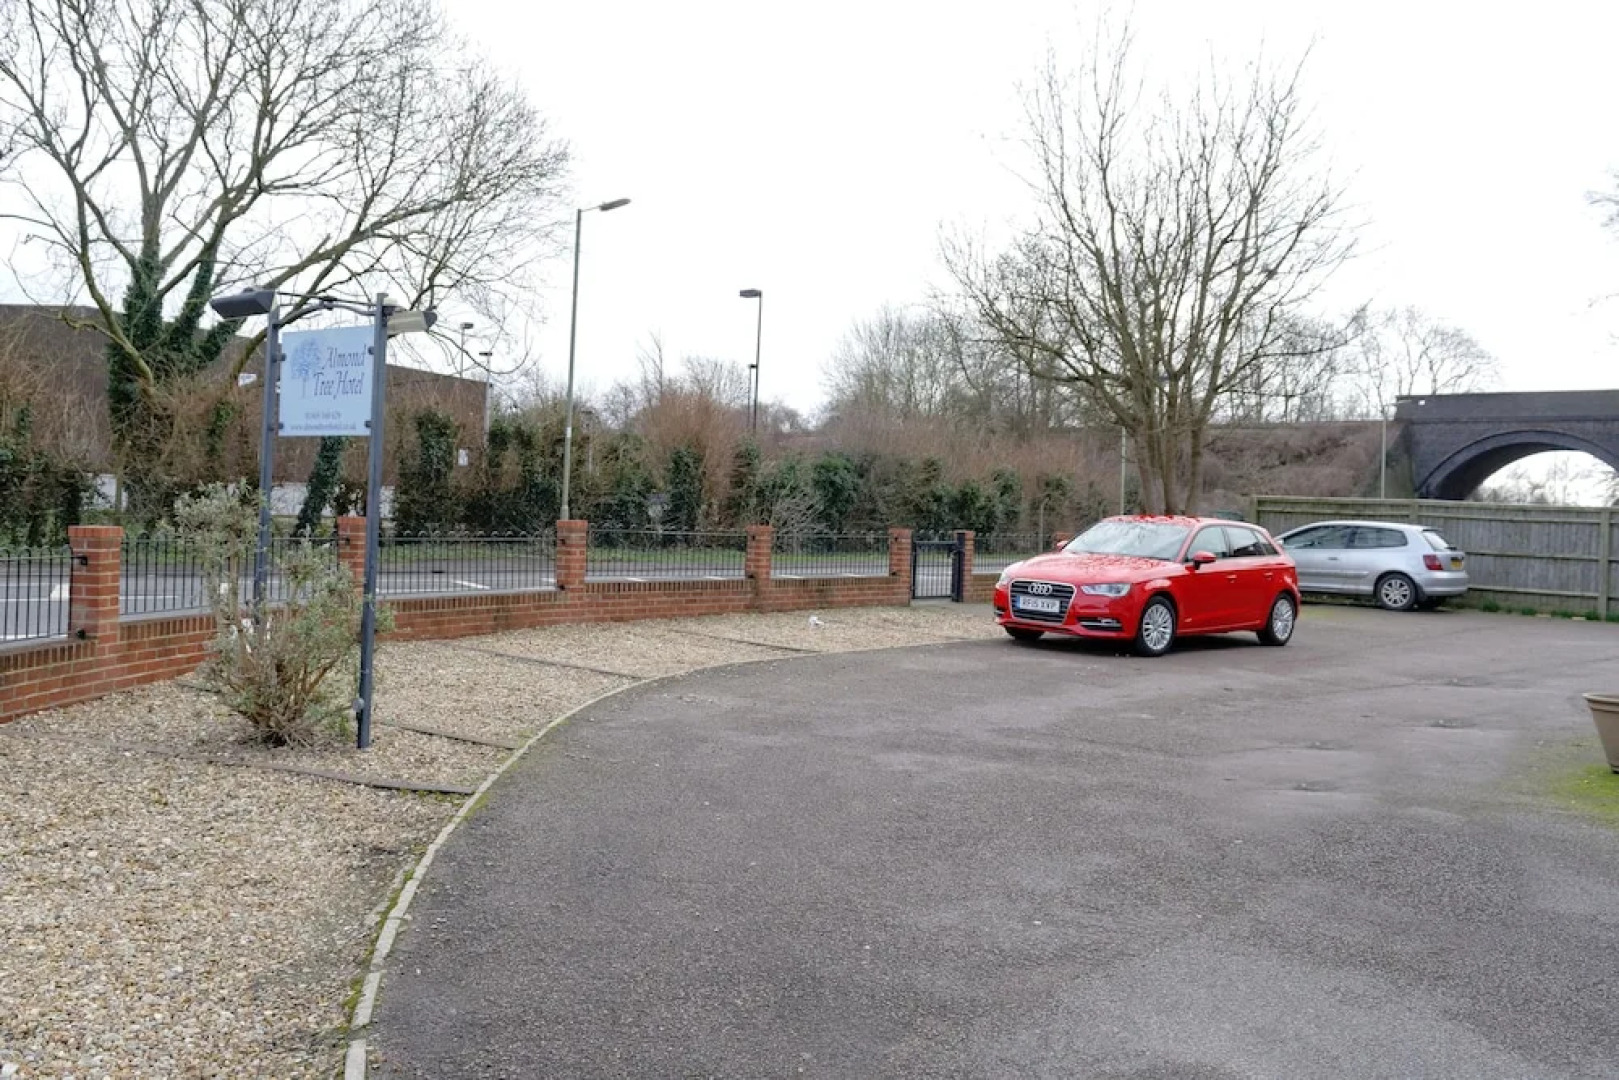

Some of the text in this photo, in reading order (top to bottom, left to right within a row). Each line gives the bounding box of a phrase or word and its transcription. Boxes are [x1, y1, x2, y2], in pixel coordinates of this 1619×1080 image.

[323, 344, 367, 369] Almond
[313, 371, 365, 400] Tree Hotel
